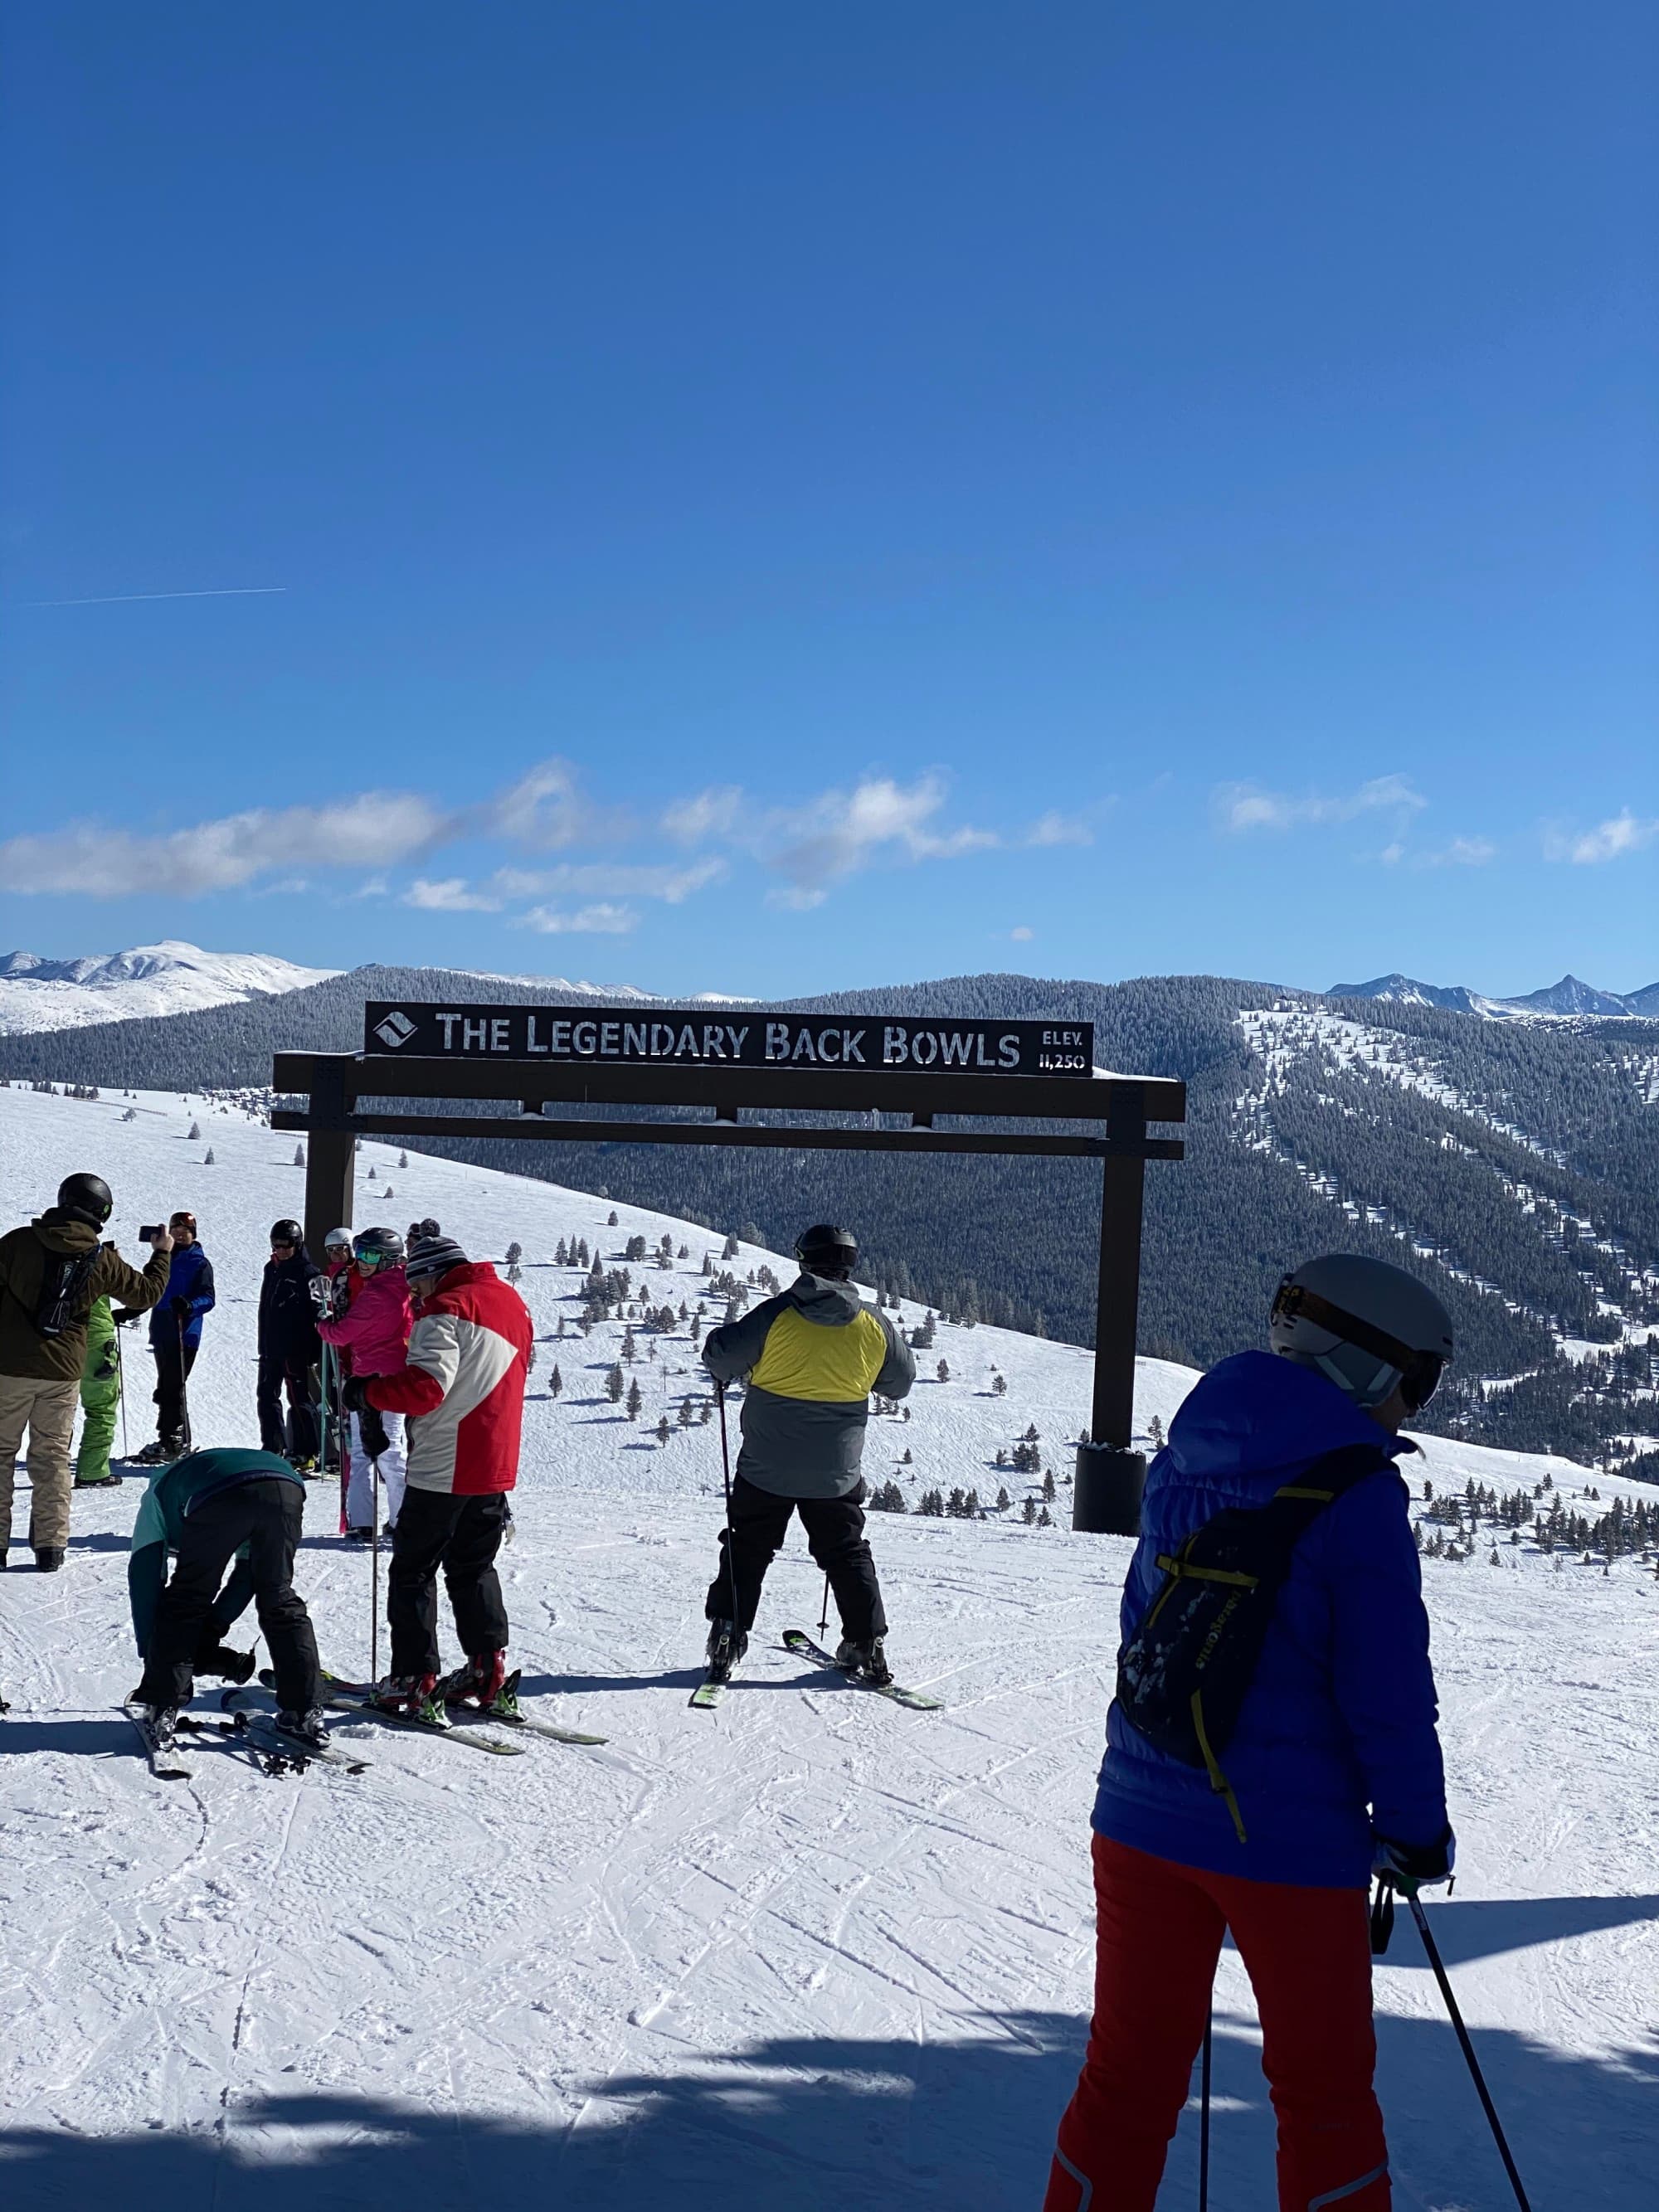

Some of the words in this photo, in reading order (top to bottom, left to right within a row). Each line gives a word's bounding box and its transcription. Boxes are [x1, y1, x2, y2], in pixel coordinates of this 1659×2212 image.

[435, 1013, 510, 1051] THE
[527, 1015, 750, 1058] LEGENDARY
[765, 1023, 867, 1063] BACK
[883, 1026, 1020, 1068] BOWLS
[1039, 1053, 1085, 1070] 11,250
